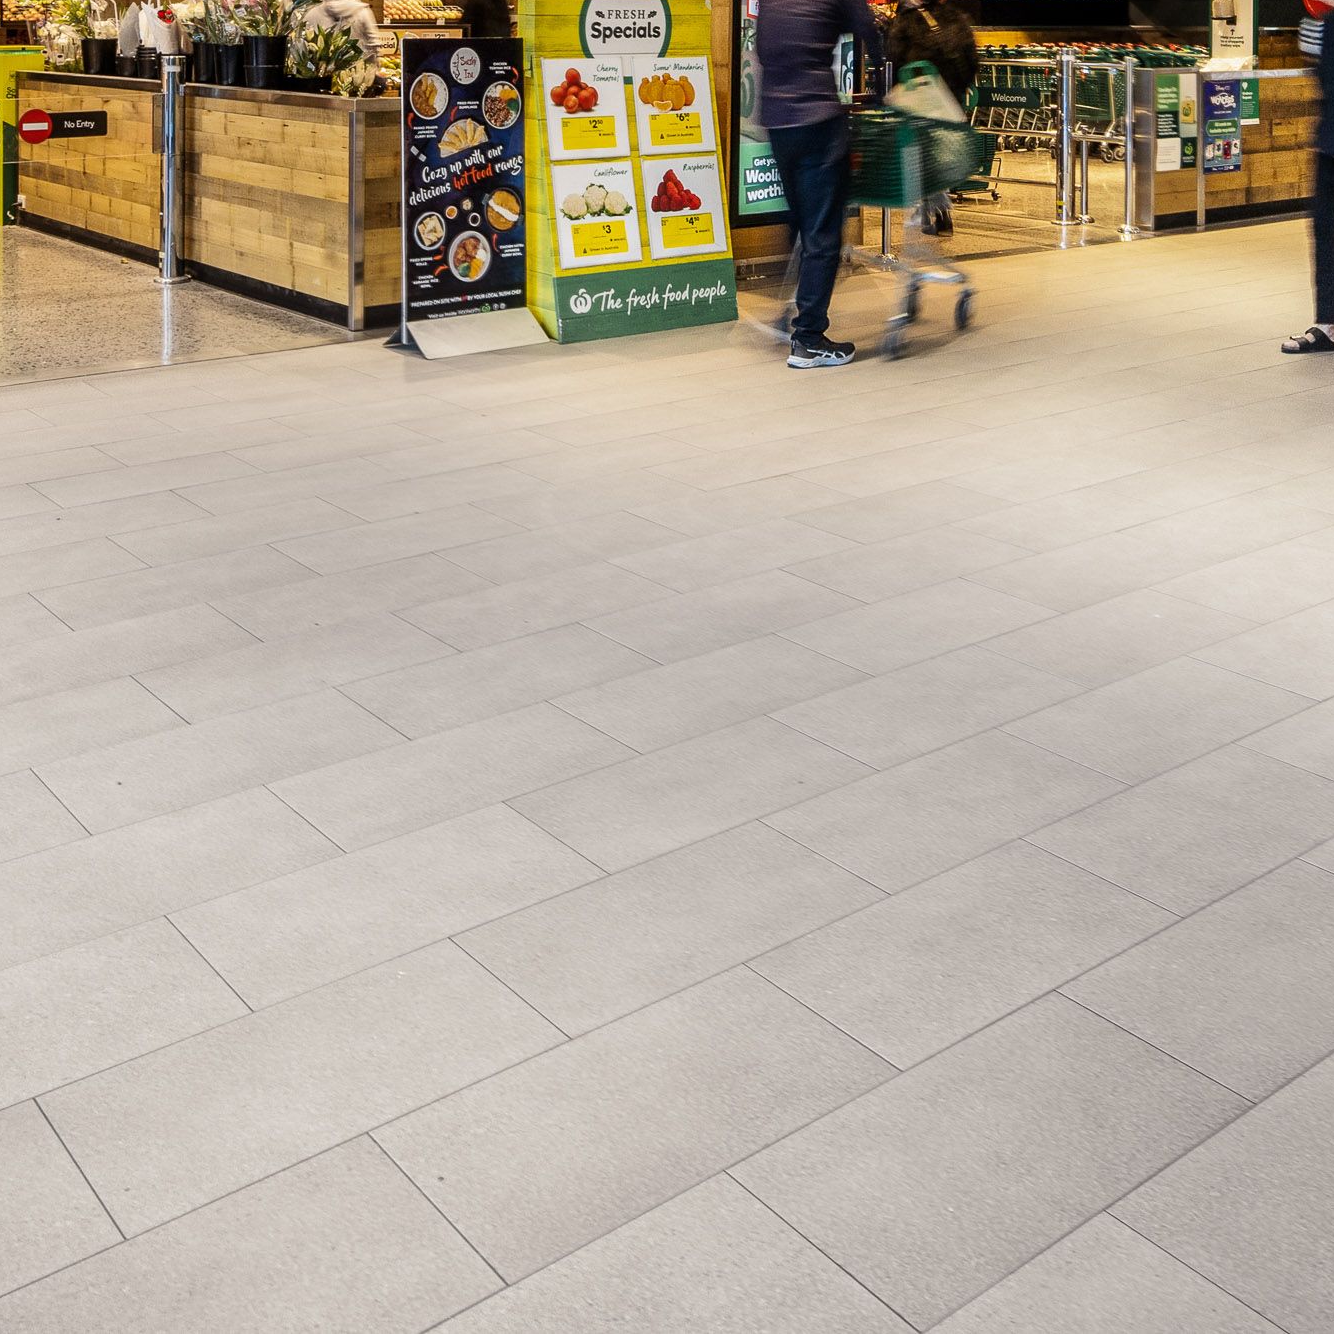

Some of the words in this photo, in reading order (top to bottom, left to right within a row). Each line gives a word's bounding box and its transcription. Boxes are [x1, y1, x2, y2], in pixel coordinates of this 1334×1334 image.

[607, 9, 646, 20] FRESH
[591, 21, 661, 43] Specials
[596, 64, 618, 73] Cherry
[991, 93, 1026, 102] Welcome
[64, 120, 74, 128] No
[76, 120, 95, 129] Entry
[422, 166, 447, 183] Cozy
[450, 161, 462, 175] up
[464, 149, 485, 167] with
[488, 145, 503, 158] our
[754, 158, 766, 166] Get
[594, 168, 628, 177] Cauliflower
[683, 163, 715, 172] Raspberries
[409, 183, 451, 206] delicious
[453, 170, 469, 190] hot
[467, 163, 493, 183] food
[495, 155, 524, 176] range
[746, 168, 782, 183] Wooli
[747, 183, 784, 201] worth!
[602, 224, 612, 233] $3
[592, 288, 623, 312] The
[626, 287, 660, 315] fresh
[662, 283, 689, 310] food
[692, 280, 727, 305] people
